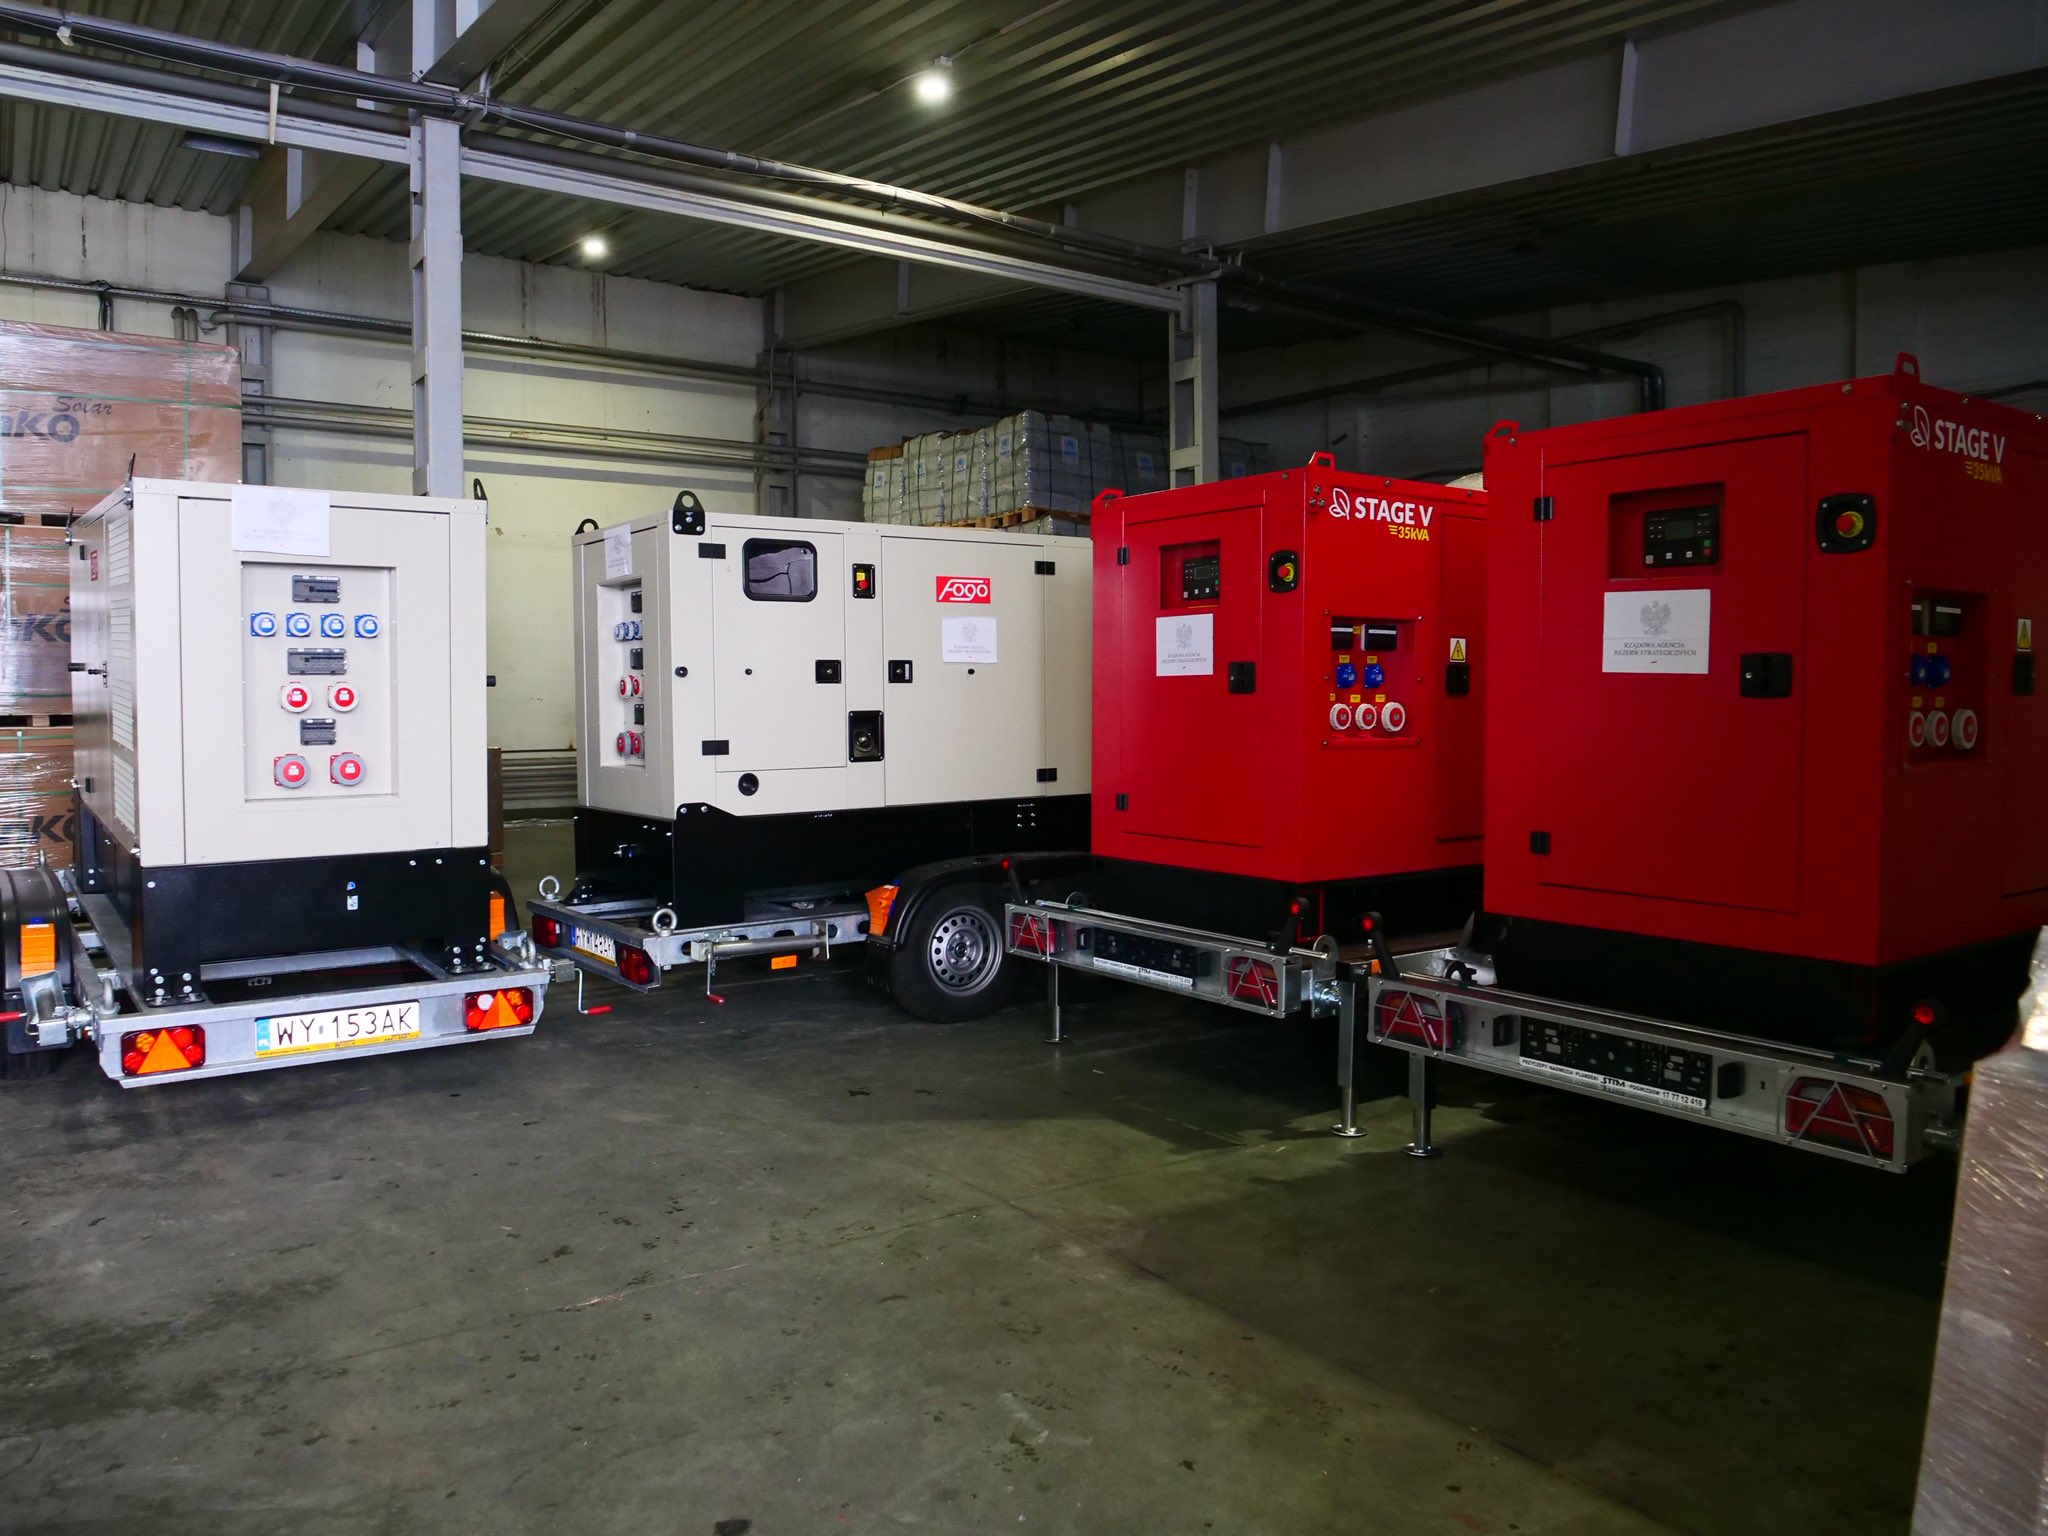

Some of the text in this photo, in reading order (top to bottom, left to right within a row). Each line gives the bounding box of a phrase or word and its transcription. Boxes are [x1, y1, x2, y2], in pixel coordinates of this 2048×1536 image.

[53, 396, 113, 415] Solar
[1934, 419, 2005, 464] STAGE V
[1972, 462, 2003, 484] 35kVA
[1354, 496, 1434, 527] STAGE V
[1397, 525, 1430, 542] 35kVA
[277, 1006, 412, 1046] WY 153AK
